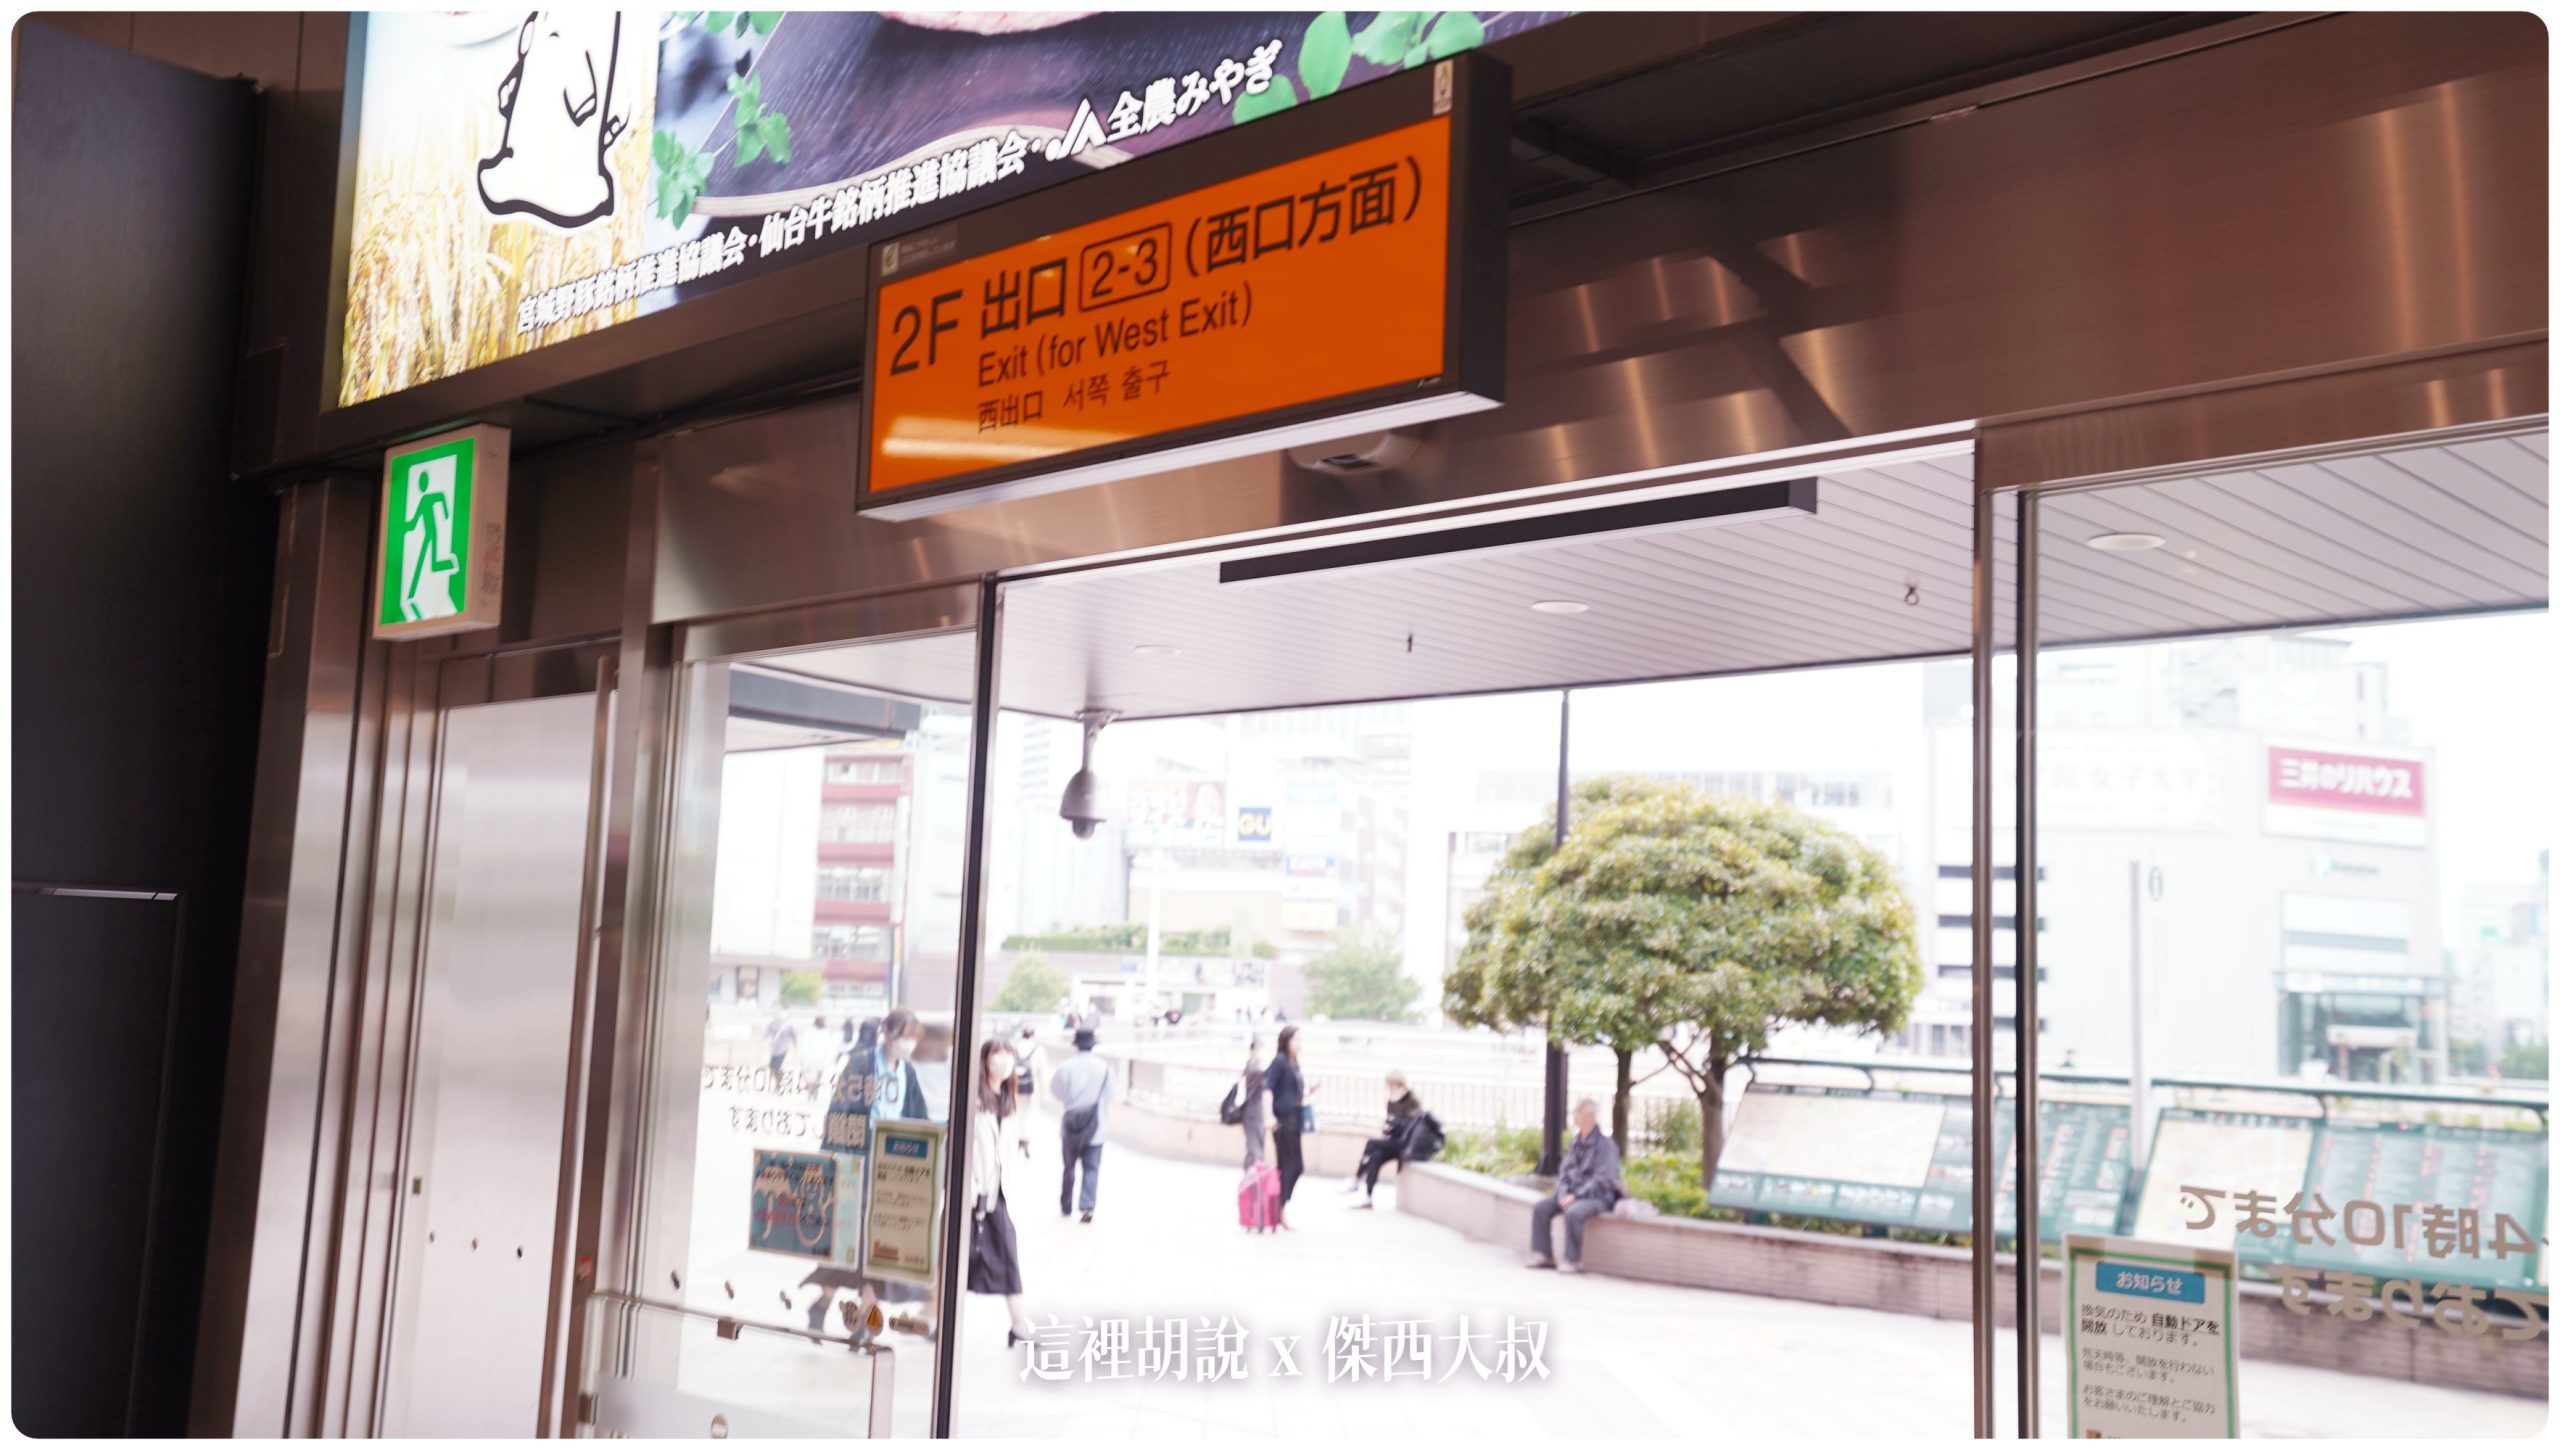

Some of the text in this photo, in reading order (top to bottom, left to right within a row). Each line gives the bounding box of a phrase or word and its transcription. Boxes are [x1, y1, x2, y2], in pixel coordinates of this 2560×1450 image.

[1107, 39, 1283, 143] 全農みやぎ
[889, 155, 1422, 377] 2F 出口 2-3 （西口方面）
[978, 280, 1252, 388] Exit (for West Exit)
[1062, 359, 1171, 412] 서쪽 출구
[977, 390, 1044, 434] 西出口
[2278, 757, 2414, 799] 三井のリハウス
[2116, 1271, 2184, 1296] お知らせ
[2151, 1312, 2220, 1335] 自動ドアを
